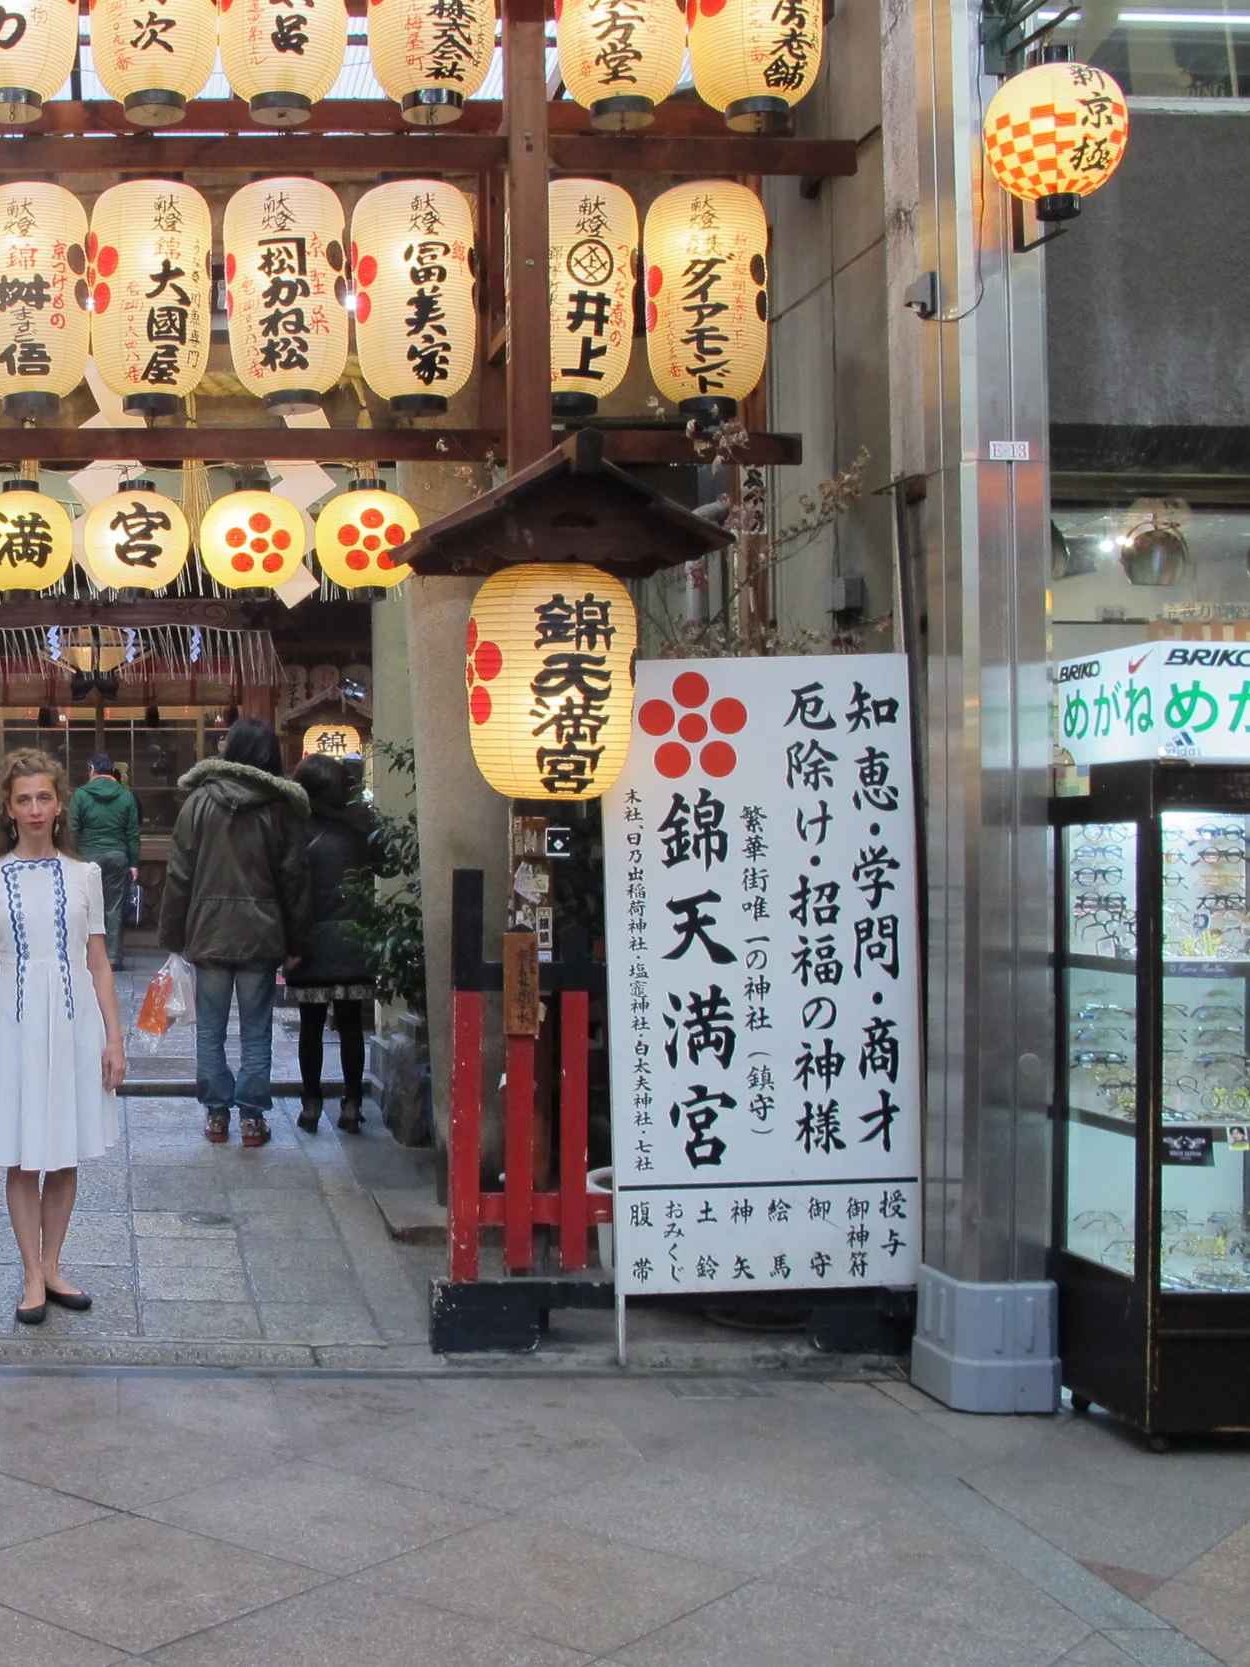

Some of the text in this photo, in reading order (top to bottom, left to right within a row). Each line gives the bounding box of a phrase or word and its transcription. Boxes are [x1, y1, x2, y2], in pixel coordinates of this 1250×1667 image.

[130, 0, 176, 53] 次
[1066, 63, 1116, 172] 新京極
[4, 197, 39, 239] 献燈
[151, 193, 185, 235] 献燈
[153, 236, 182, 261] 錦
[262, 191, 298, 233] 献燈
[409, 192, 446, 236] 献燈
[575, 194, 613, 239] 献燈
[689, 194, 721, 231] 献燈
[6, 243, 40, 270] 錦
[49, 239, 68, 330] 京つけもの
[609, 243, 627, 348] つくだ煮の
[140, 258, 192, 386] 大國屋
[258, 276, 311, 373] かね松
[561, 289, 612, 381] 井上
[680, 253, 736, 395] ダイアモンド
[991, 441, 1028, 461] E-13
[109, 502, 172, 569] 宮
[528, 591, 617, 795] 錦天満宮
[1058, 660, 1101, 683] BRIKO
[1062, 682, 1154, 741] めがね
[316, 731, 347, 755] 錦
[782, 681, 848, 1155] 厄除け・招福の神様
[844, 681, 902, 1153] 知恵・学問・商才
[657, 788, 739, 1170] 錦天満宮
[628, 1203, 655, 1283] 腹帯
[662, 1202, 686, 1285] おみくじ
[695, 1201, 720, 1280] 土鈴
[730, 1200, 756, 1281] 神矢
[766, 1200, 792, 1280] 絵馬
[807, 1196, 834, 1278] 御守
[846, 1196, 871, 1278] 御神符
[879, 1190, 909, 1257] 授与
